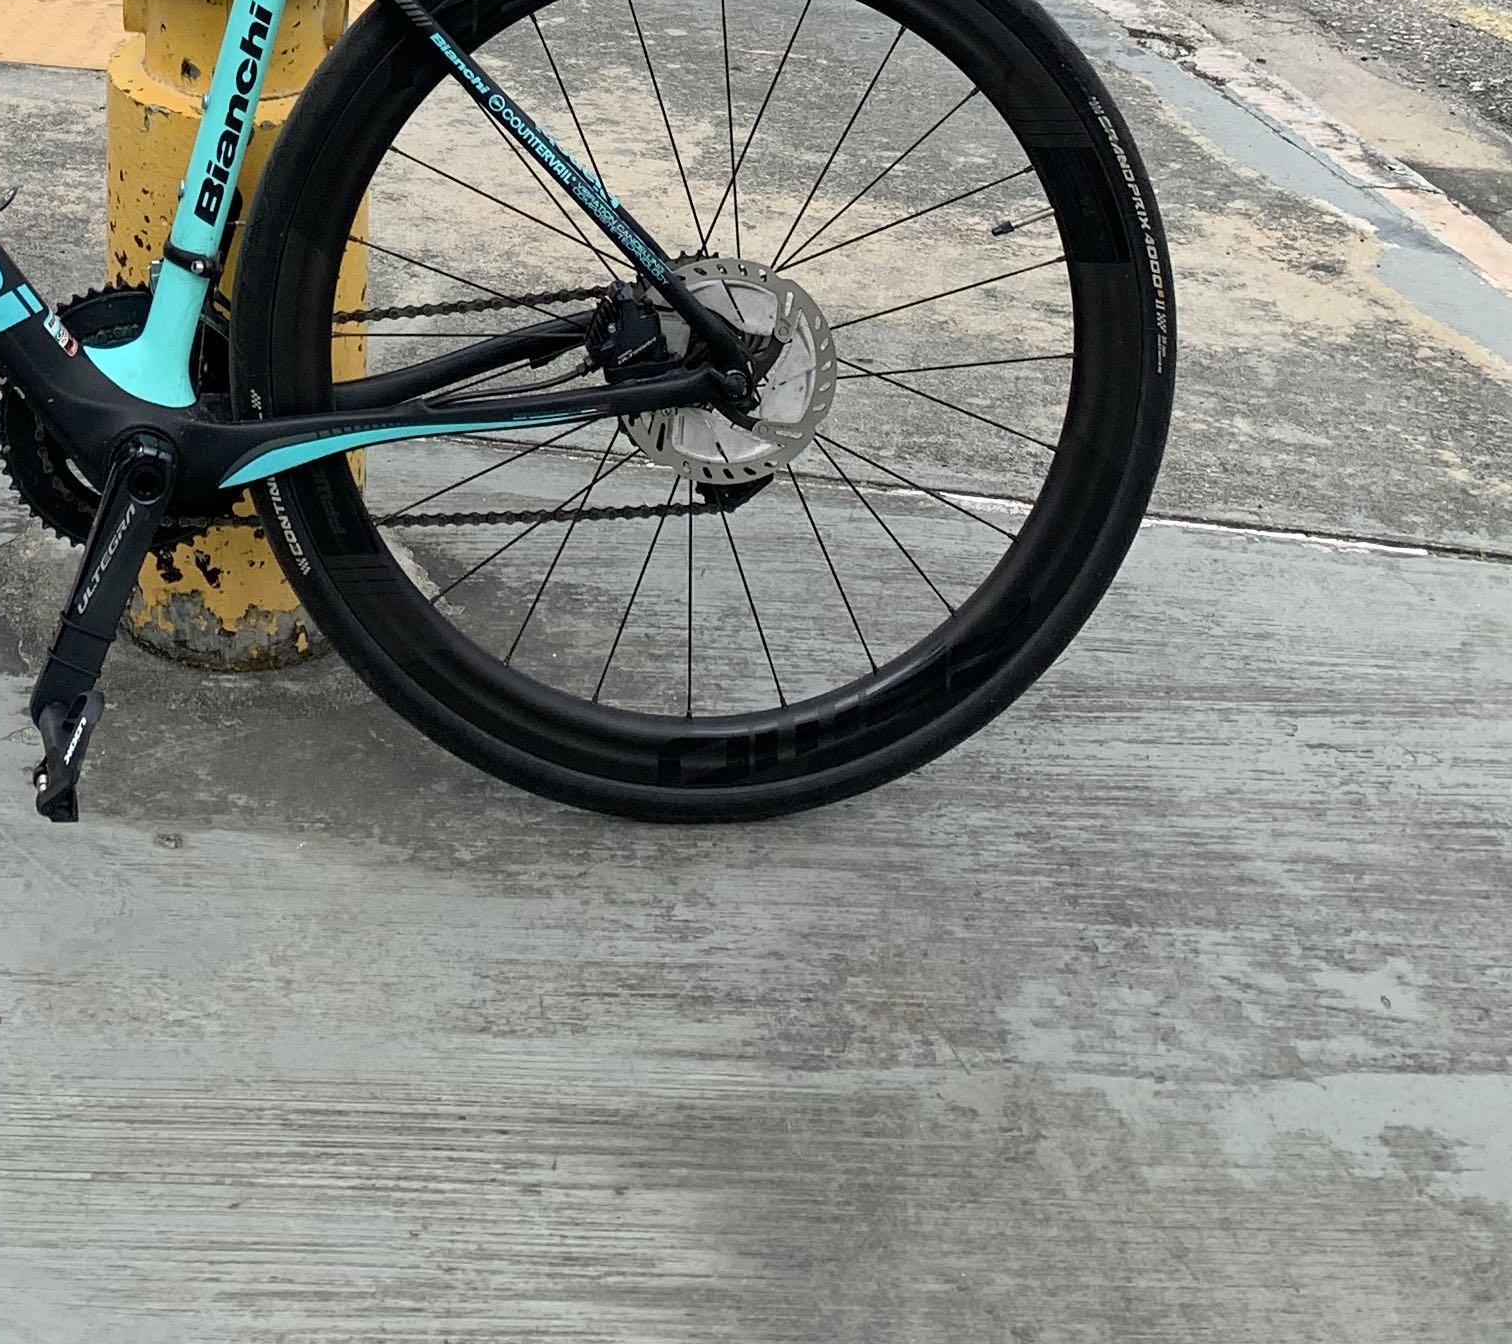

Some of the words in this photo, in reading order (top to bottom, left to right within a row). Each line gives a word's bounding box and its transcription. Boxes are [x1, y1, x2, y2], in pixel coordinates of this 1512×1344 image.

[430, 32, 490, 94] Bianchi
[194, 0, 273, 227] Bianchi
[502, 108, 573, 185] COUNTERVAIL
[576, 181, 618, 227] VIBRATION
